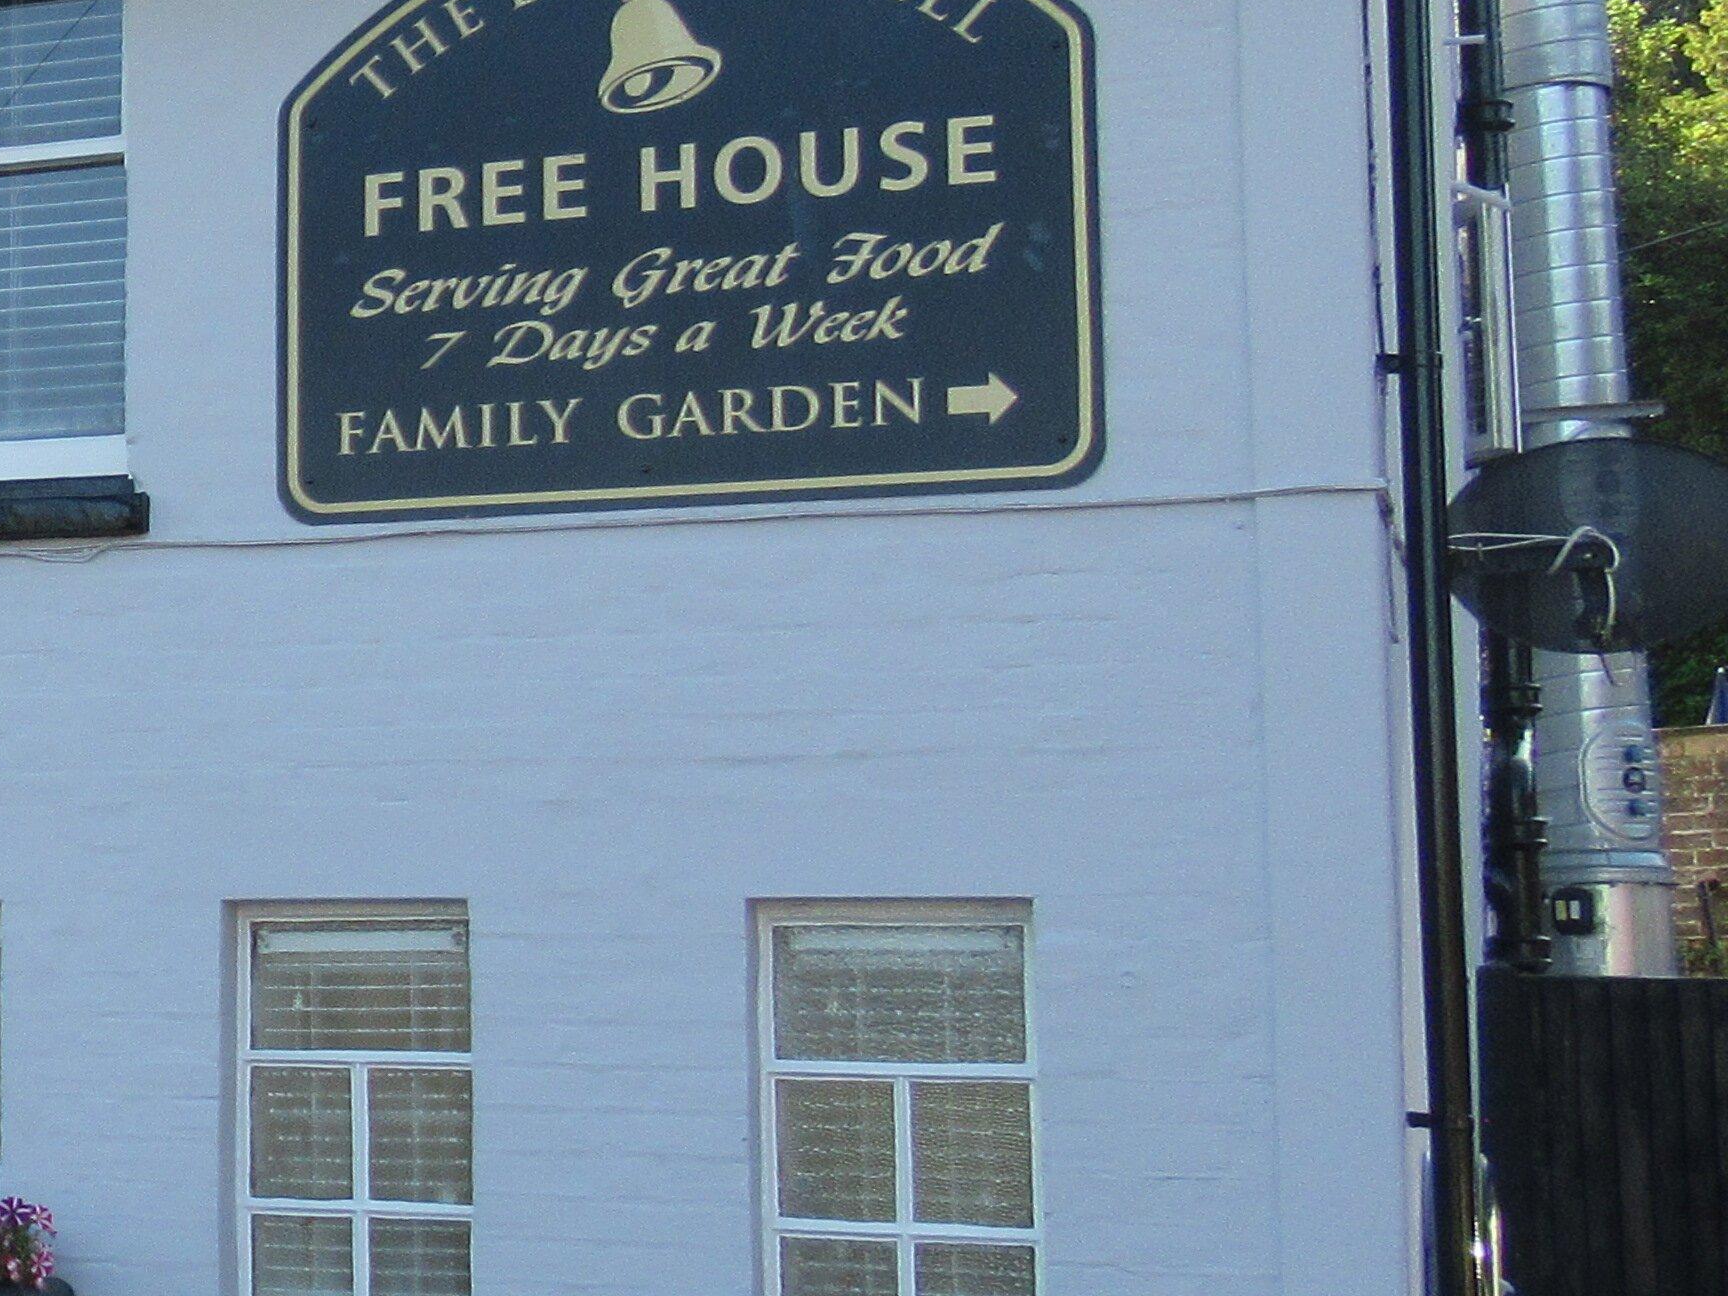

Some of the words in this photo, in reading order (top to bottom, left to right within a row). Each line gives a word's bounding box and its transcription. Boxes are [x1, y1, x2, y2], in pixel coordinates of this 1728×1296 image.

[363, 153, 588, 237] FREE
[639, 115, 997, 212] HOUSE
[350, 263, 589, 320] Serving
[611, 243, 801, 307] Great
[826, 222, 1005, 284] Food
[420, 333, 465, 370] 7
[487, 319, 657, 371] Days
[675, 324, 712, 354] a
[752, 295, 910, 348] Week
[336, 398, 583, 456] FAMILY
[617, 377, 926, 441] GARDEN
